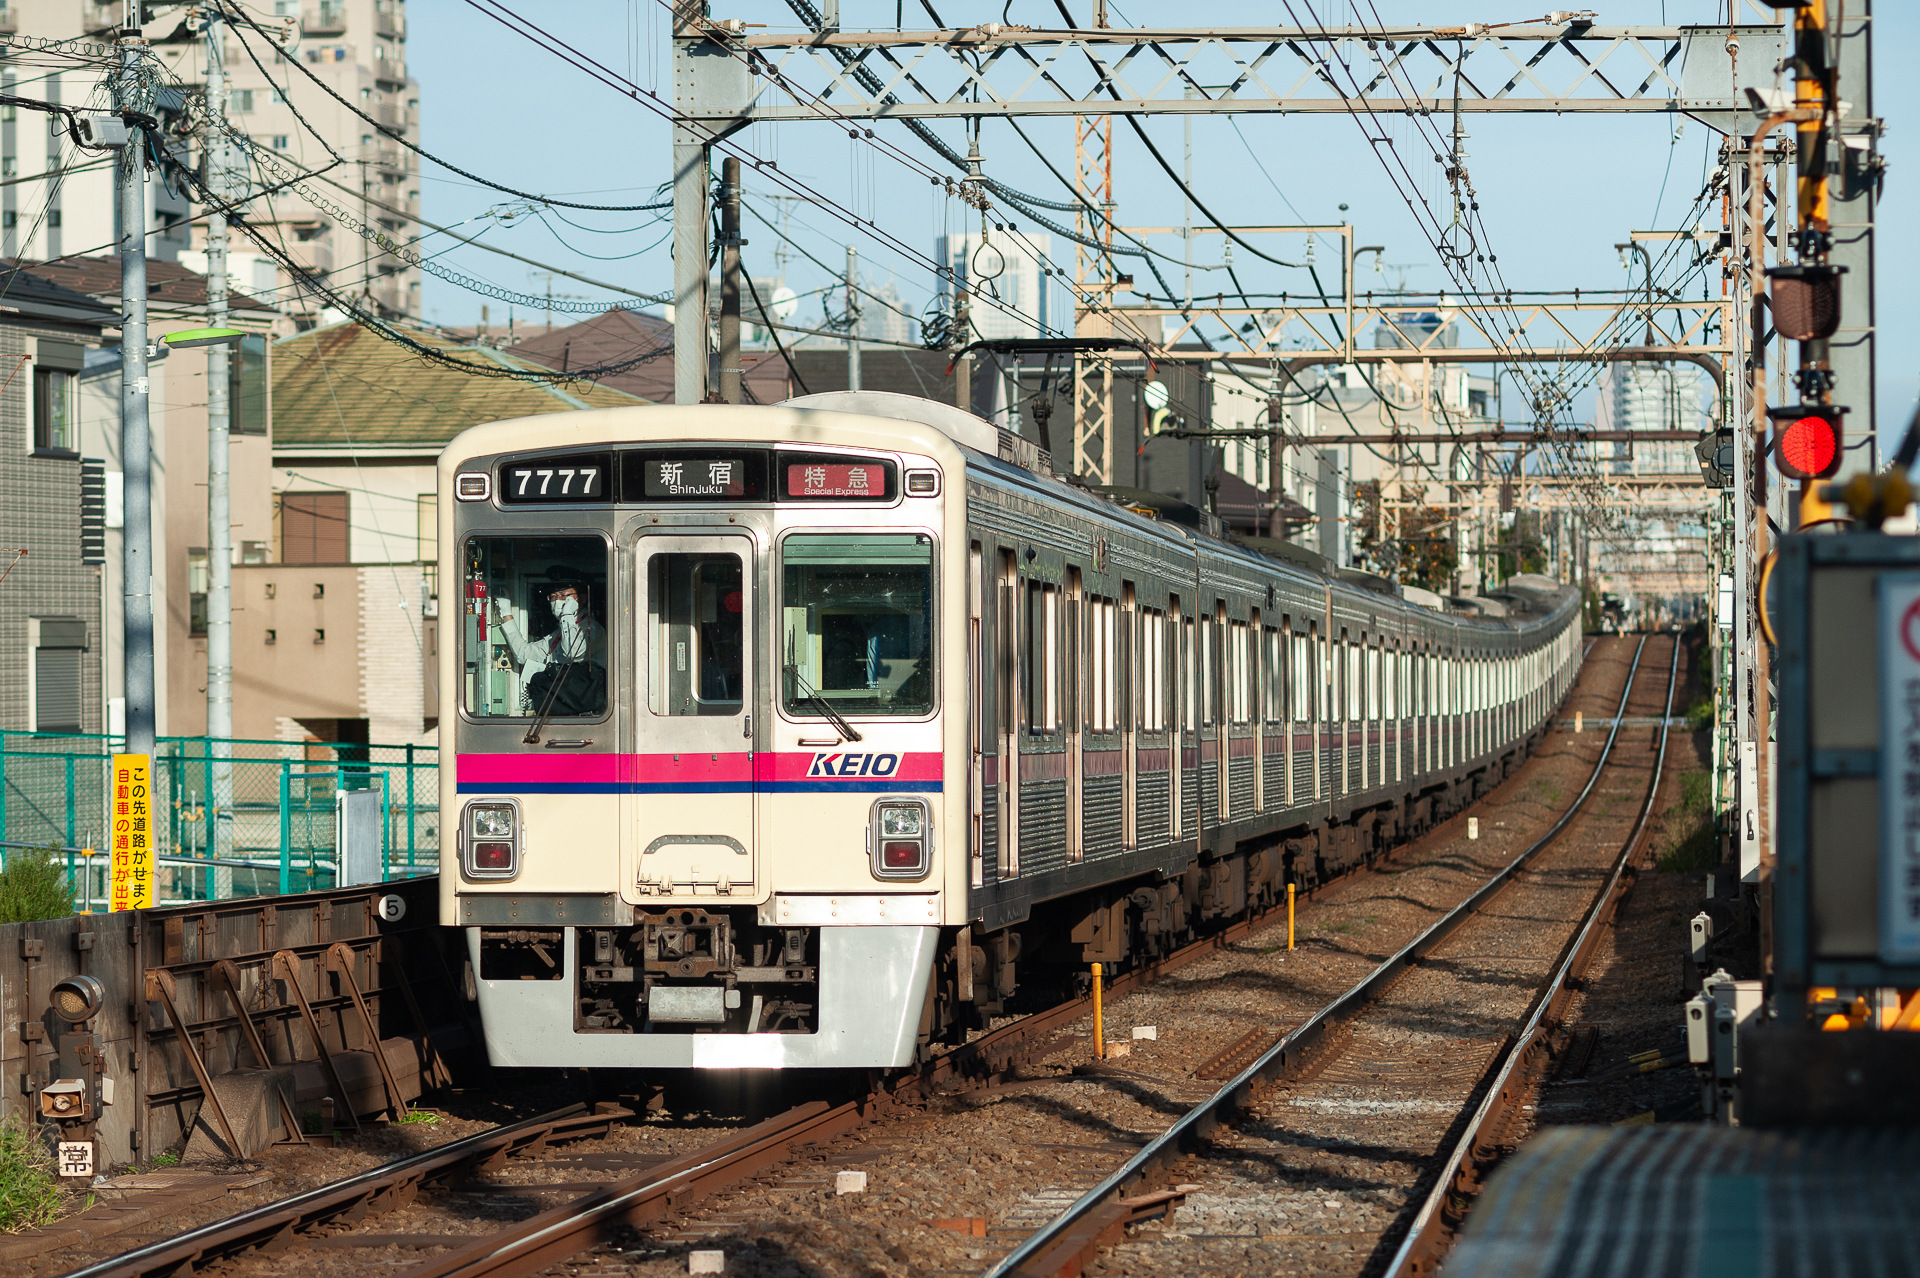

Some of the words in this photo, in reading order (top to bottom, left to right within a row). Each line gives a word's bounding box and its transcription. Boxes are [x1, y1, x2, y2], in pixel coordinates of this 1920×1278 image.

[514, 468, 597, 495] 7777
[660, 461, 732, 486] 新宿
[804, 467, 869, 488] 特急
[804, 487, 834, 495] Special
[835, 487, 869, 496] Express
[810, 753, 898, 776] KEIO
[132, 767, 147, 910] この先道路がせまく
[386, 899, 399, 916] 5
[64, 1146, 88, 1173] 常
